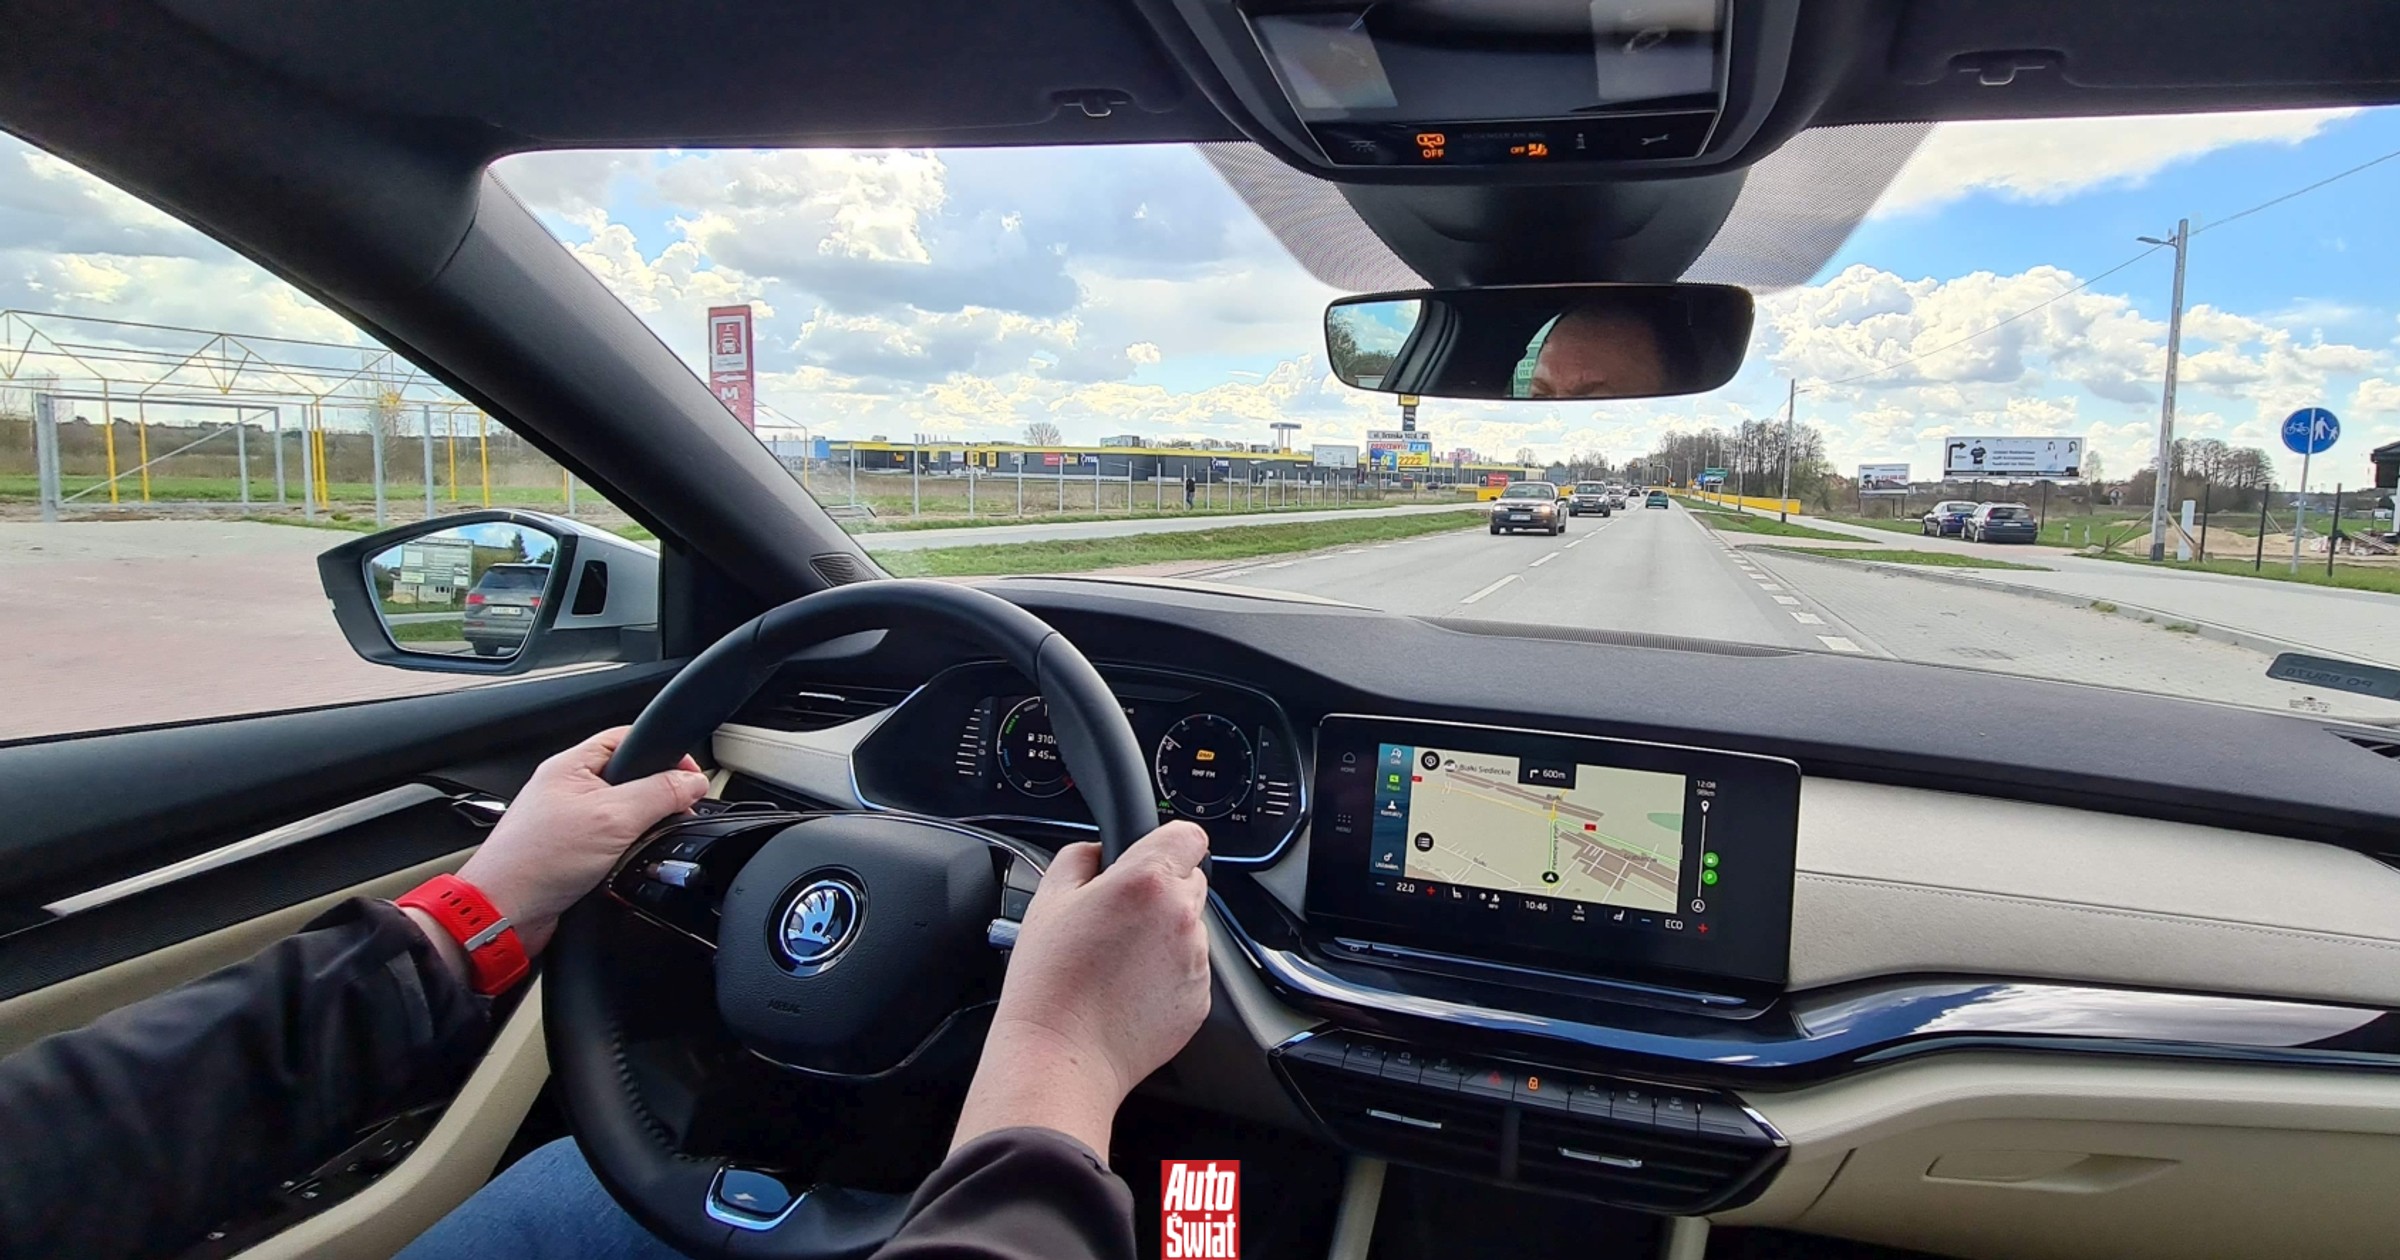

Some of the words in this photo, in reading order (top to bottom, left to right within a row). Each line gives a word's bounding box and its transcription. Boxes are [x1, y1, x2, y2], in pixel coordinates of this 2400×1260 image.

[1423, 149, 1444, 158] OFF
[1037, 750, 1049, 760] 45
[1340, 766, 1356, 774] HOME
[1396, 882, 1416, 893] 22.0
[1525, 899, 1549, 911] 10:46
[1664, 919, 1684, 930] ECO
